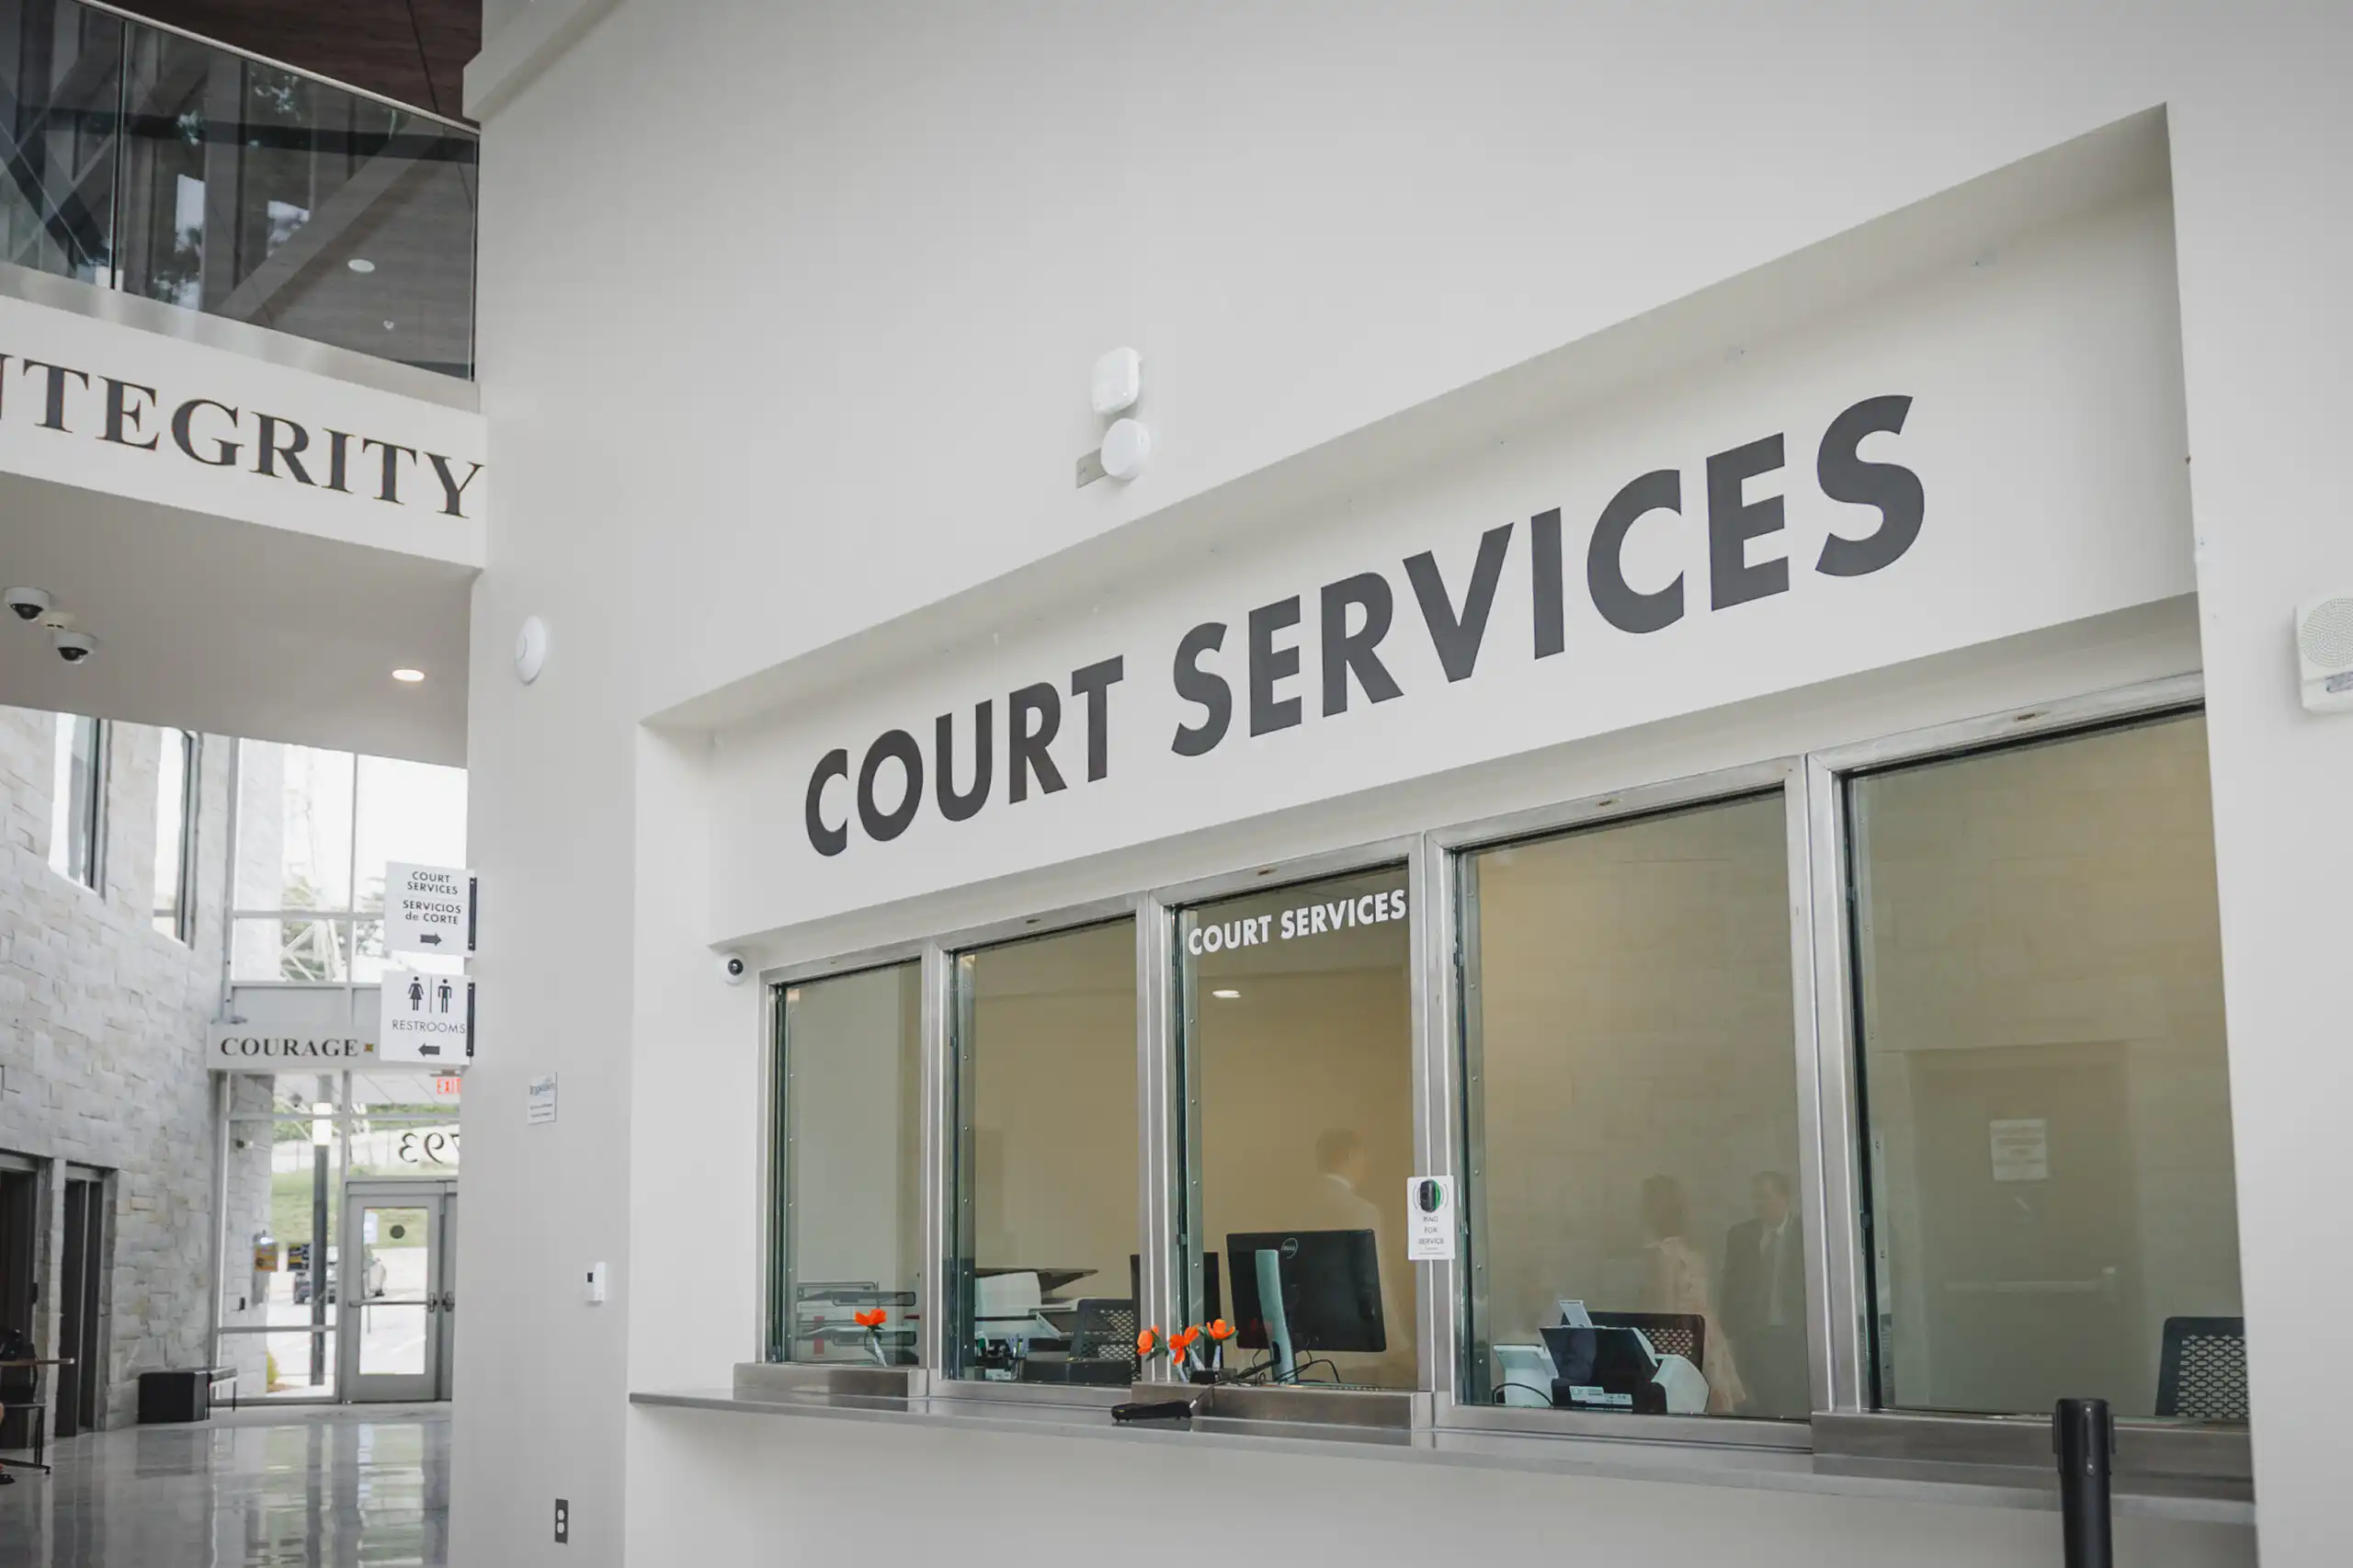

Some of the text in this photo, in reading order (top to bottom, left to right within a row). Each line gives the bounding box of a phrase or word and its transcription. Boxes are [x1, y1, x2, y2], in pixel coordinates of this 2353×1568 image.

[0, 353, 484, 519] TEGRITY
[804, 393, 1926, 858] COURT SERVICES
[412, 871, 451, 883] COURT
[406, 881, 458, 895] SERVICES
[402, 900, 461, 915] SERVICIOS
[404, 911, 459, 925] de CORTE
[1188, 889, 1407, 956] COURT SERVICES
[392, 1019, 466, 1034] RESTROOMS
[220, 1037, 358, 1057] COURAGE
